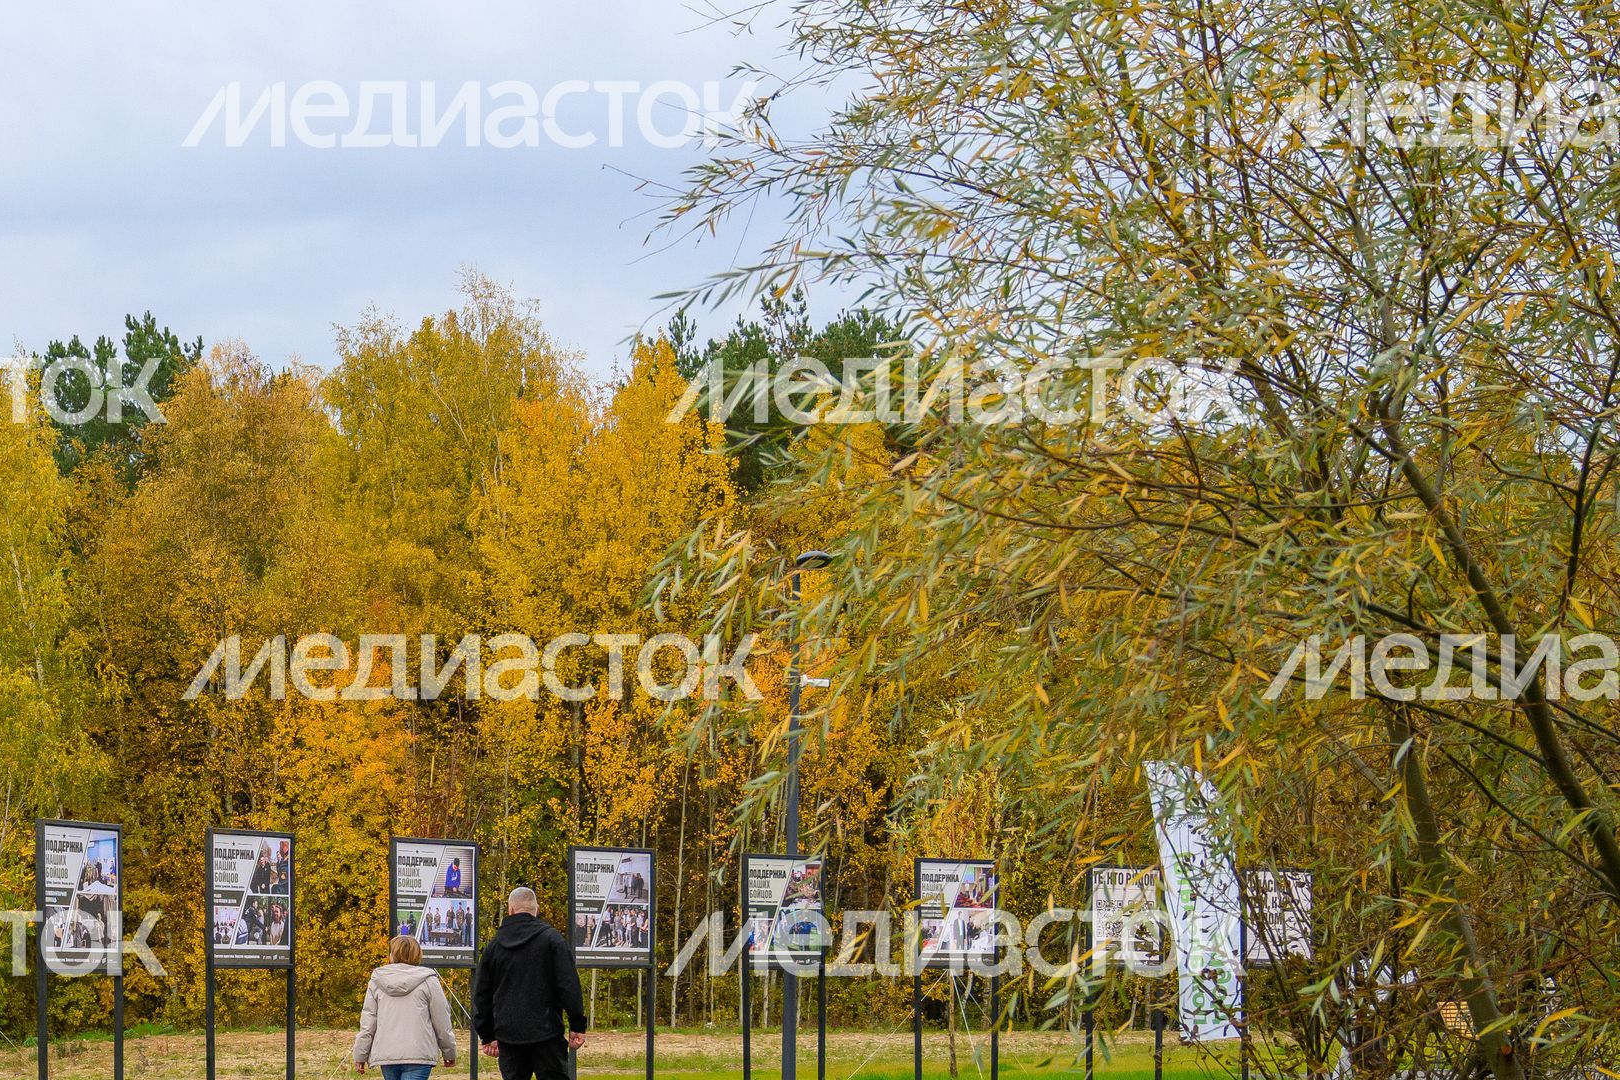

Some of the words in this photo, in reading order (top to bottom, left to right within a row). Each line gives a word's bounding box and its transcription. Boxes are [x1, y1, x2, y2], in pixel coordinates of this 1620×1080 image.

[45, 840, 83, 853] ПОДДЕРЖКА
[214, 848, 255, 860] ПОДДЕРЖКА
[214, 860, 237, 871] НАШИХ
[214, 871, 239, 884] БОЙЦОВ
